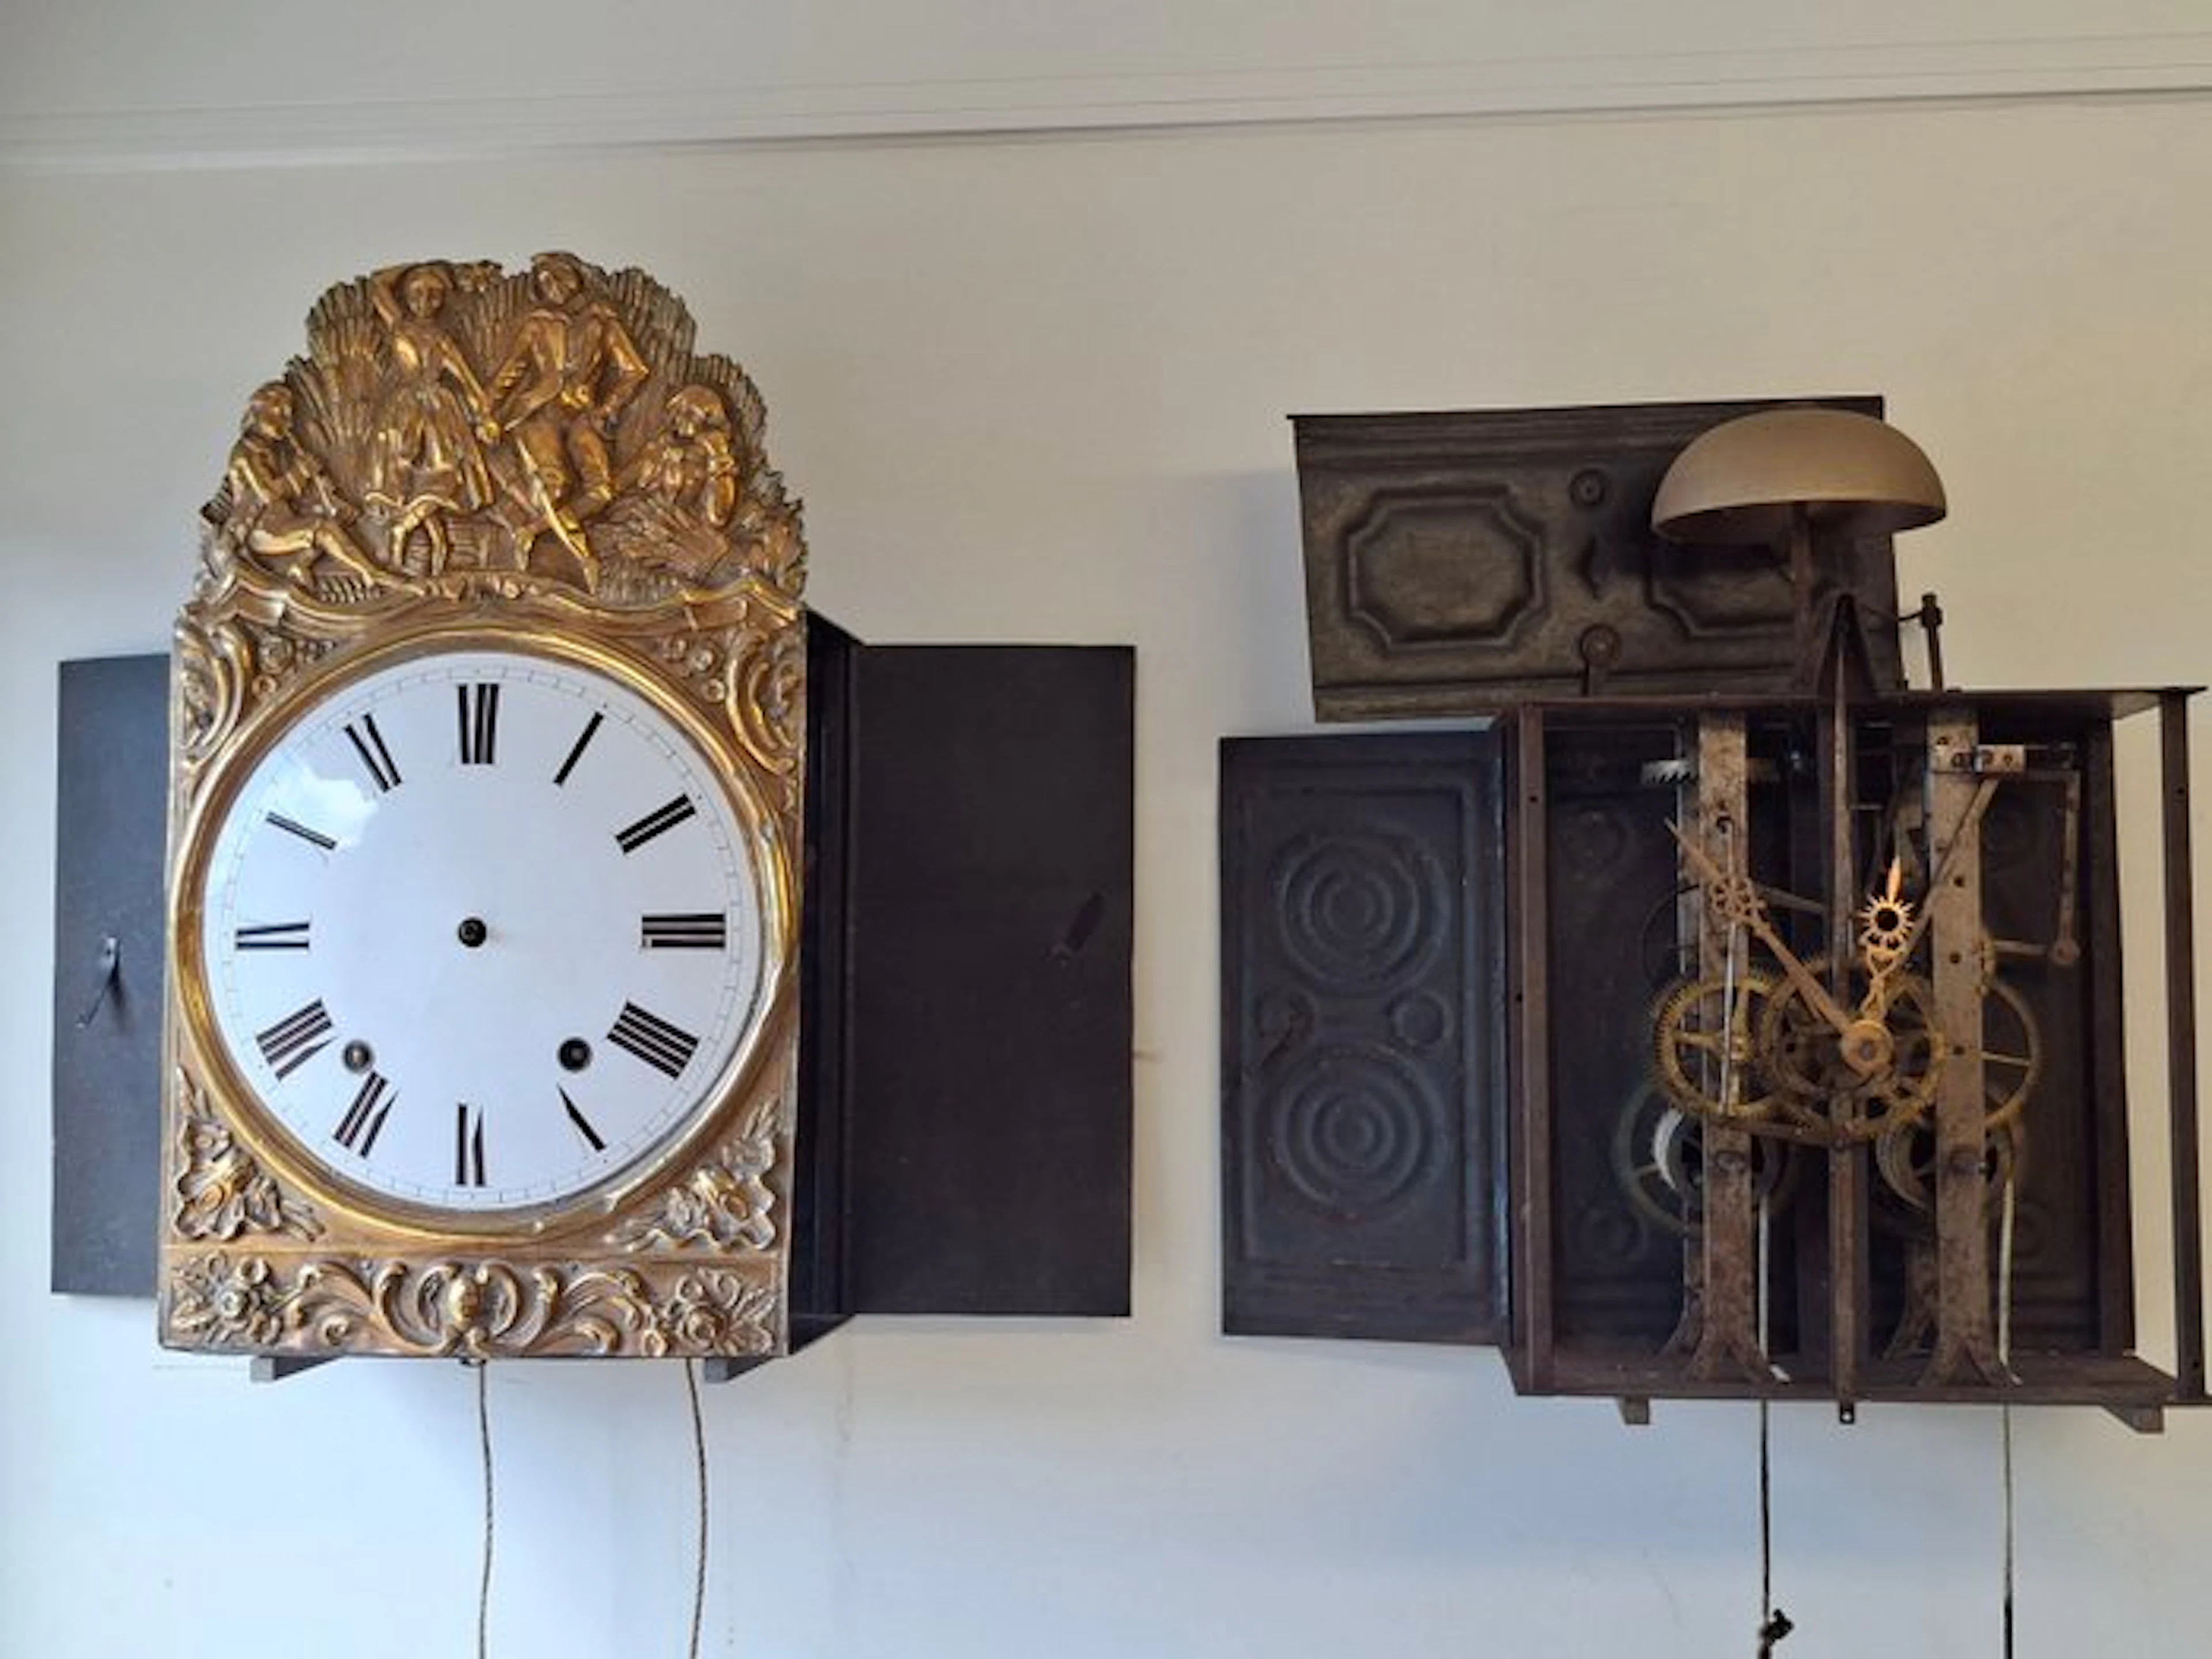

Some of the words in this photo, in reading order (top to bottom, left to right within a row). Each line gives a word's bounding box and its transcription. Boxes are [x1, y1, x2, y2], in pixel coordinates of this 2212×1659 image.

[613, 791, 698, 856] II
[641, 912, 727, 951] III
[604, 999, 701, 1081] IIII
